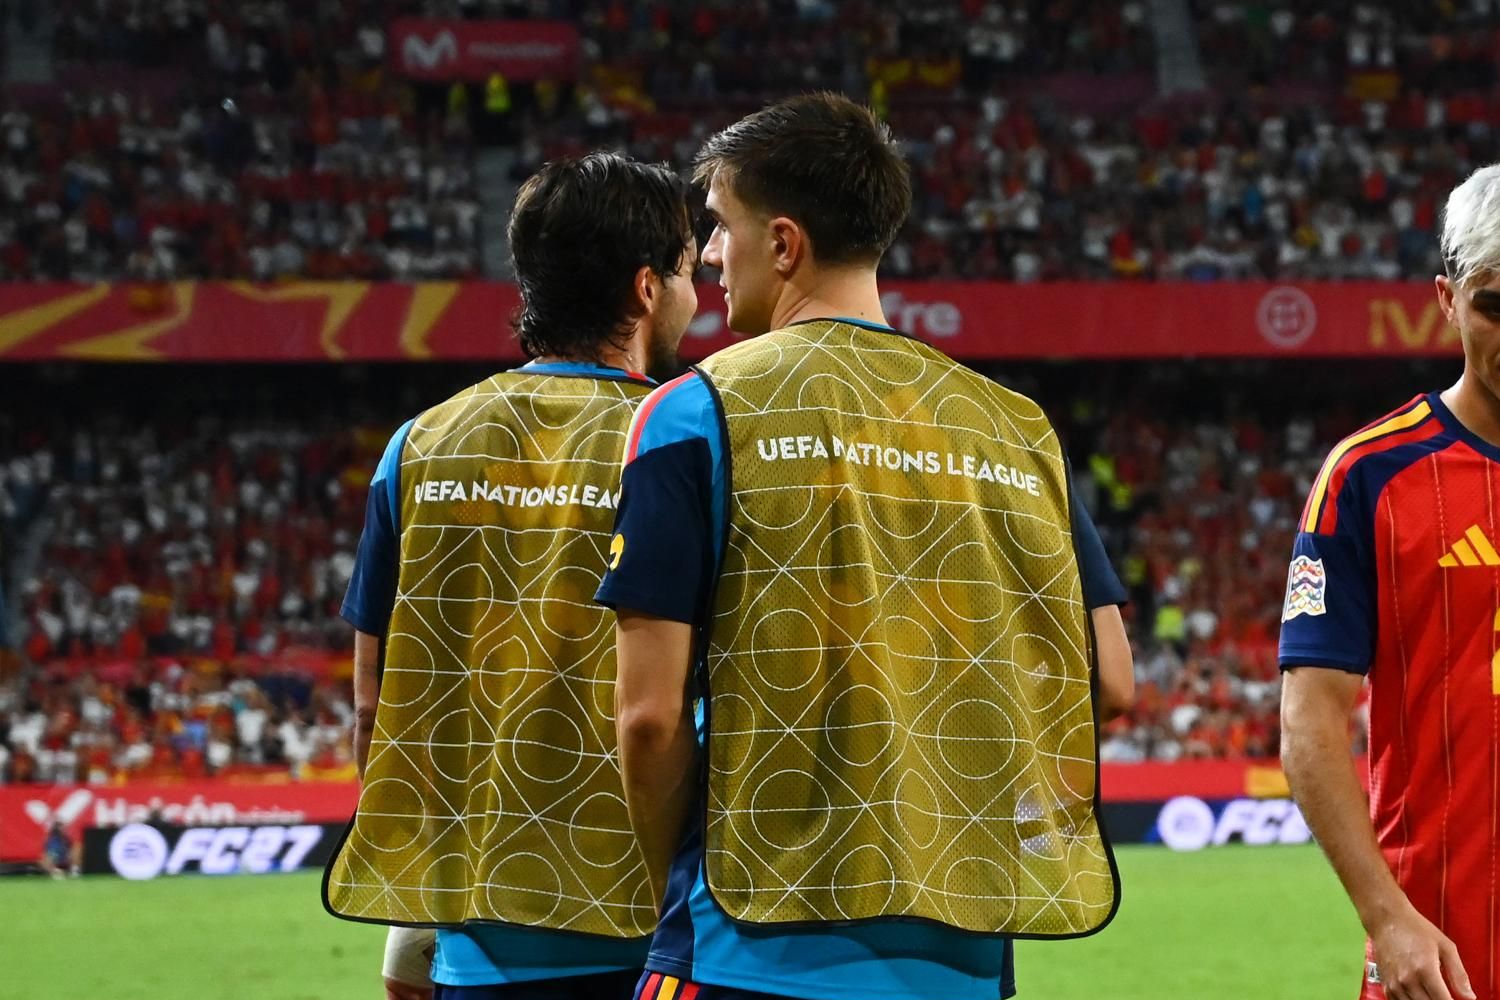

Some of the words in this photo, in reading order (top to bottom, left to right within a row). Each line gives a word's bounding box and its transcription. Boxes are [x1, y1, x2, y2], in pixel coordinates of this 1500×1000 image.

[880, 291, 961, 337] fre
[755, 436, 829, 461] UEFA
[832, 434, 941, 474] NATIONS
[947, 453, 1041, 497] LEAGUE
[414, 480, 468, 504] UEFA
[471, 480, 568, 508] NATIONS
[94, 795, 236, 828] Hacón
